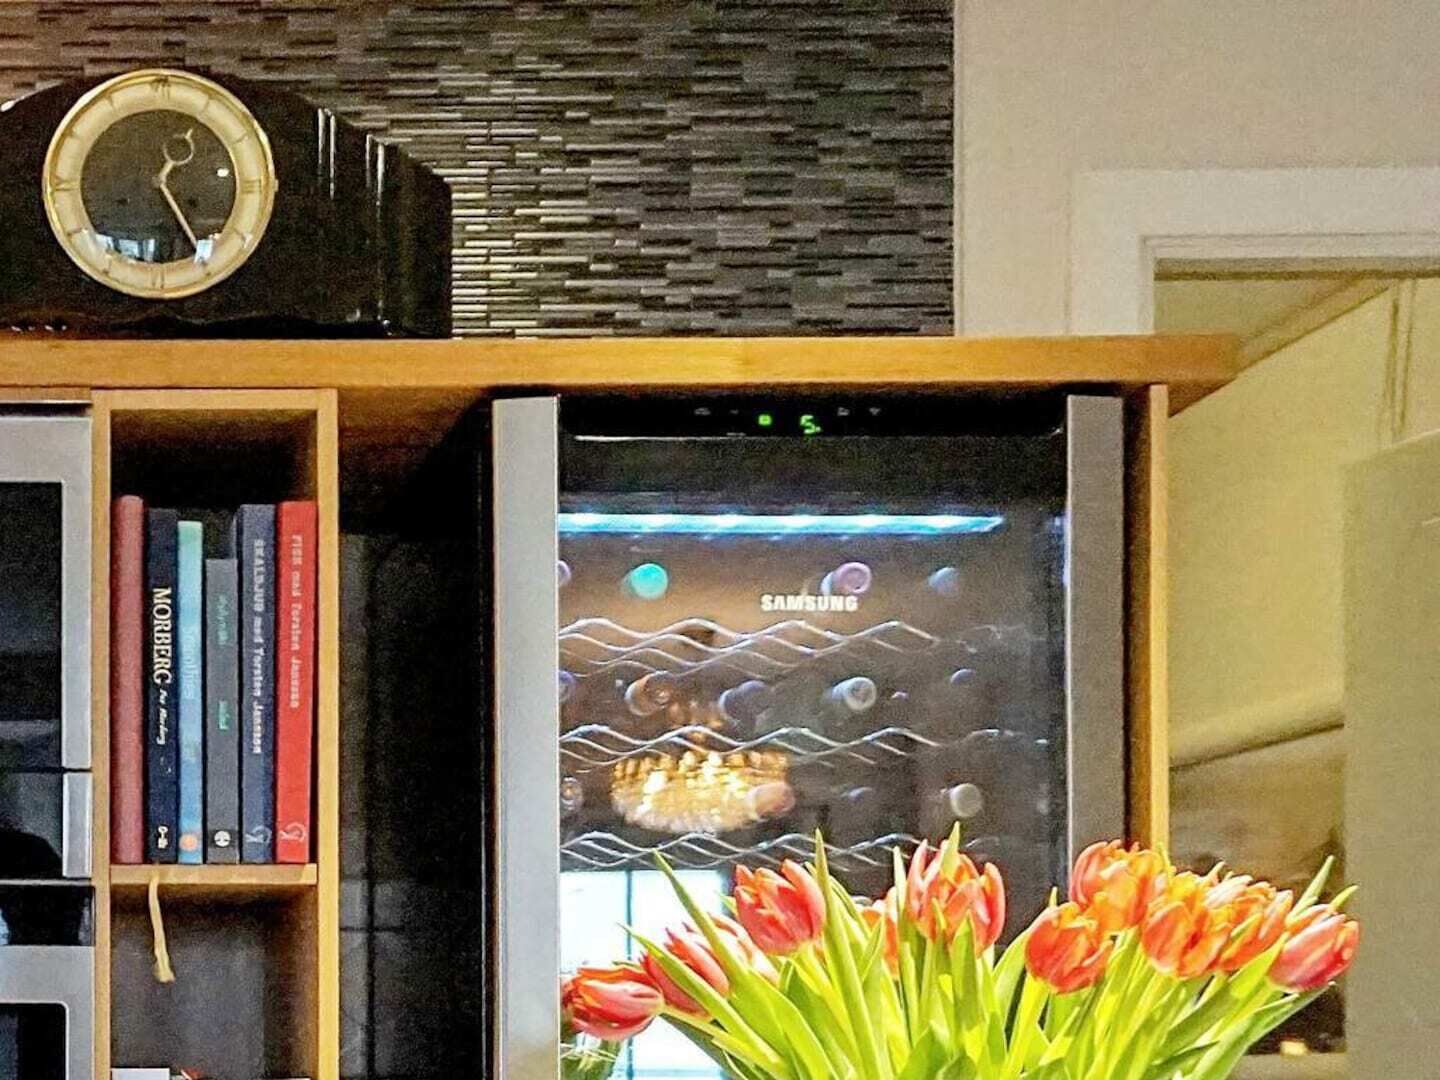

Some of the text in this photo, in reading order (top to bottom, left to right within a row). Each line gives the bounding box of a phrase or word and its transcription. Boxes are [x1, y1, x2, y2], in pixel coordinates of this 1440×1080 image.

[253, 539, 265, 612] SKALDJUR
[760, 594, 858, 612] SAMSUNG
[152, 586, 172, 685] MORBERG
[253, 616, 264, 643] med
